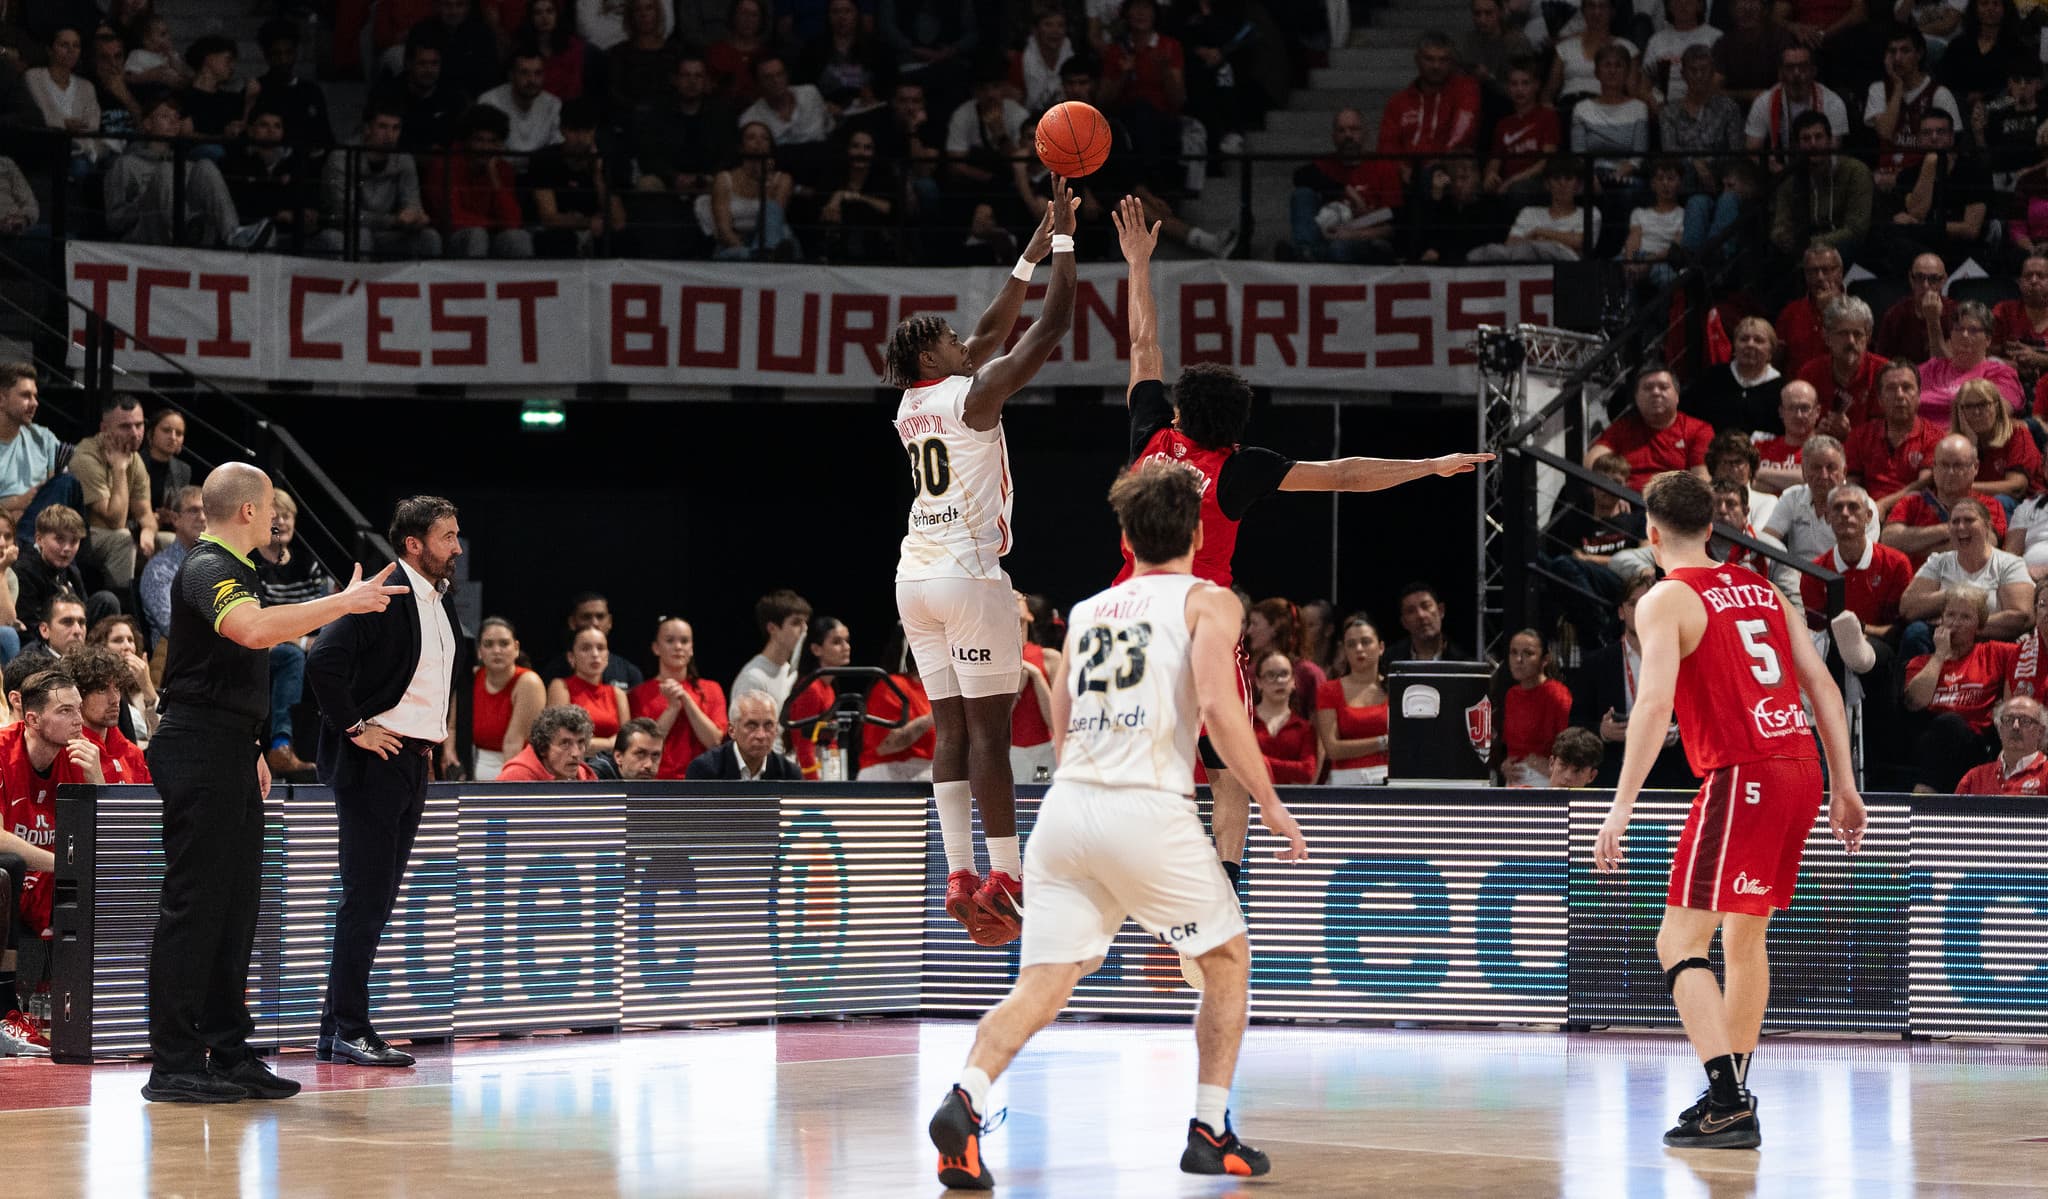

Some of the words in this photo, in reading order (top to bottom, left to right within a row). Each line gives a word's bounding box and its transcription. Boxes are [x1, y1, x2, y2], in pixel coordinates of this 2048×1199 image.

[74, 264, 250, 358] ICI
[290, 276, 557, 366] C'EST
[611, 284, 957, 375] BOUR
[959, 647, 992, 662] LCR
[1078, 622, 1153, 696] 23
[1735, 618, 1783, 688] 5
[1744, 781, 1761, 805] 5
